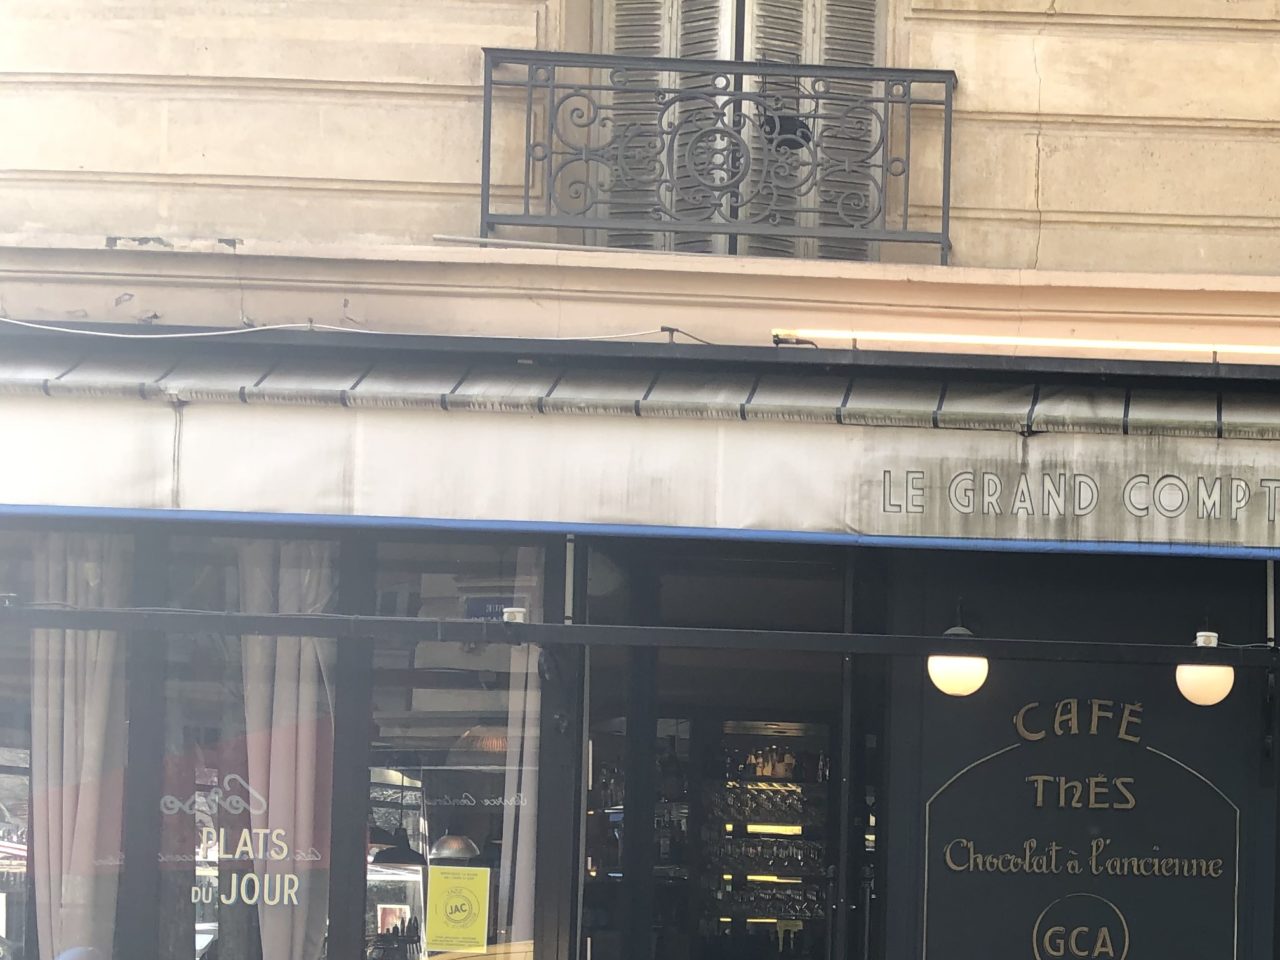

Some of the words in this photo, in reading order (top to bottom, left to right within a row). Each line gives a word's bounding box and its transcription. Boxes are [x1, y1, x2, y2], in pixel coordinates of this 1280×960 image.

[883, 470, 925, 513] LE
[948, 471, 1099, 517] GRAND
[202, 828, 289, 860] PLATS
[944, 838, 1062, 874] Chocolat
[1067, 849, 1083, 874] à
[1090, 838, 1224, 878] l'ancienne
[191, 886, 212, 904] DU
[220, 873, 299, 906] JOUR
[449, 903, 468, 915] JAC
[1043, 926, 1114, 957] GCA
